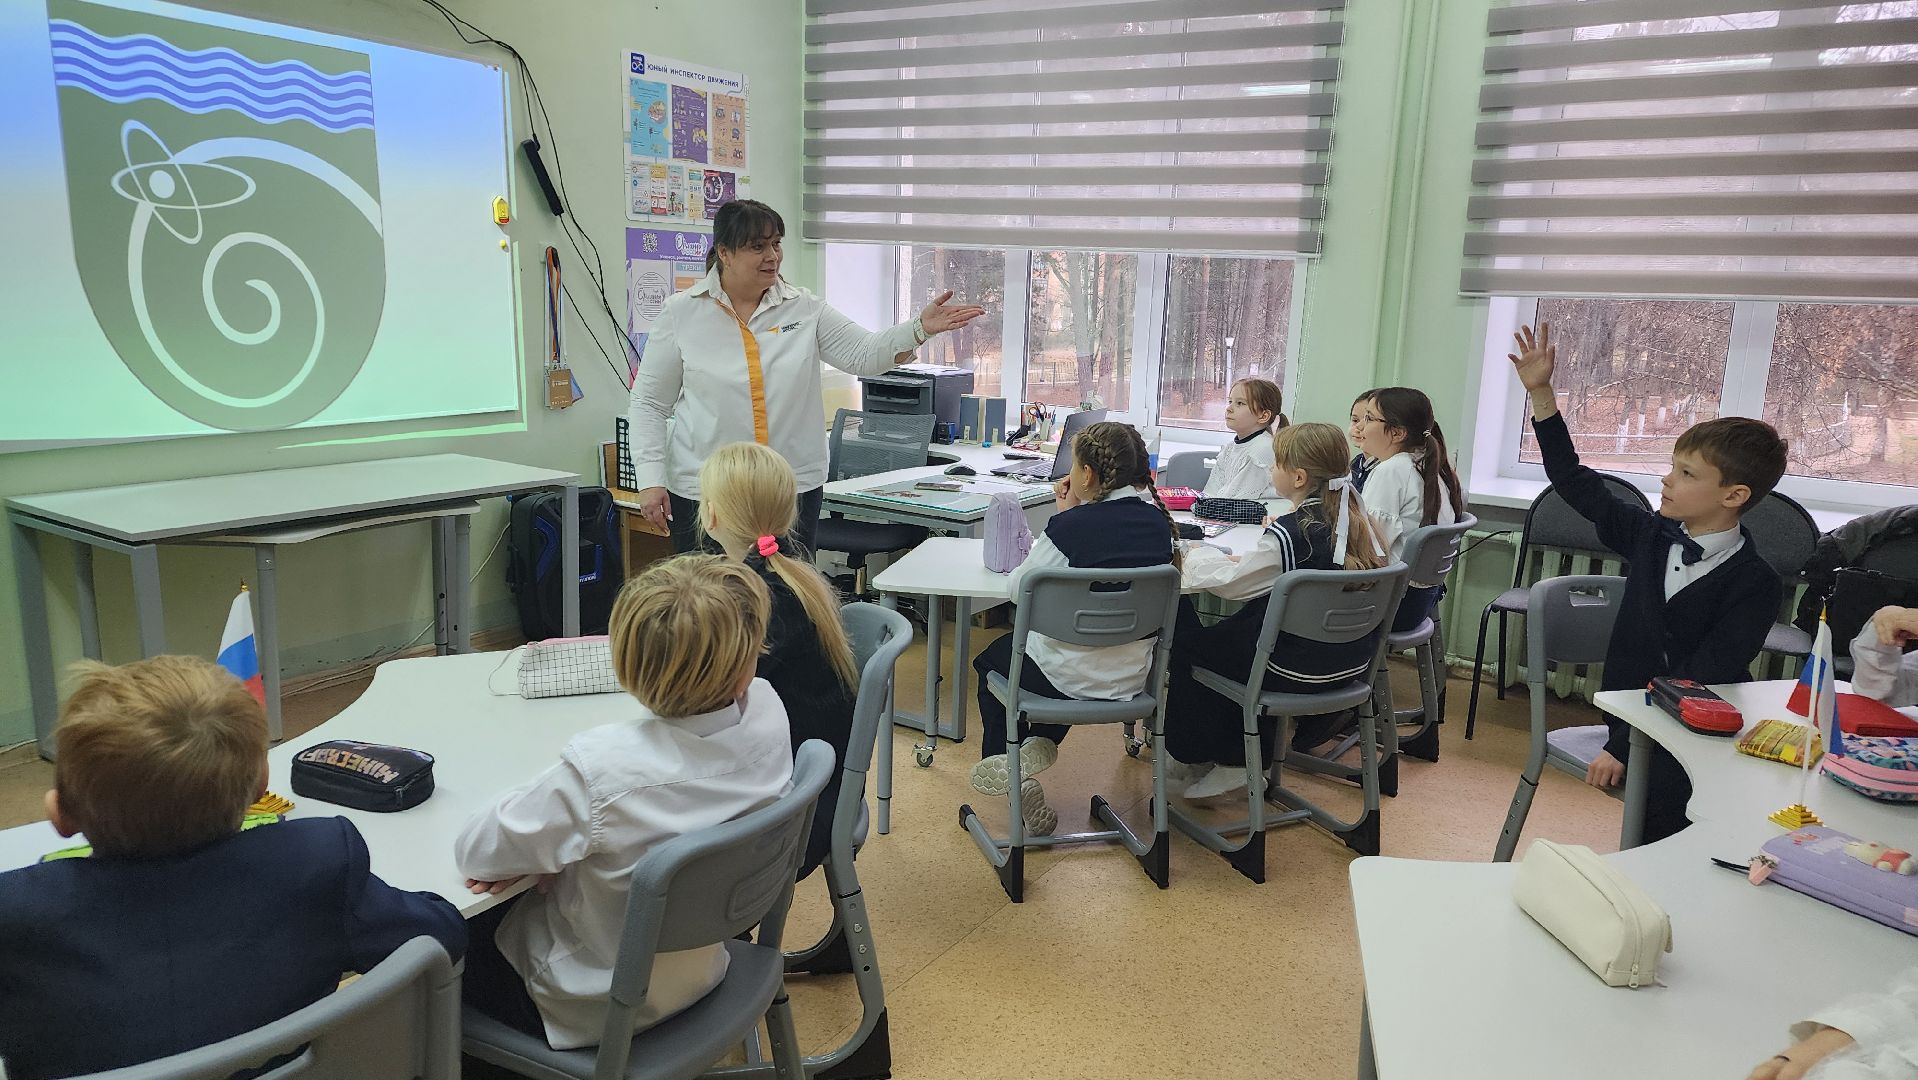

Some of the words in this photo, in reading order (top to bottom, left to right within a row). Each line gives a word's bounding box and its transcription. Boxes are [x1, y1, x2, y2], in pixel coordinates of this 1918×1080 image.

[647, 63, 668, 74] ЮНЫЙ
[670, 68, 706, 81] ИНСПЕКТОР
[707, 75, 739, 88] ДВИЖЕНИЯ
